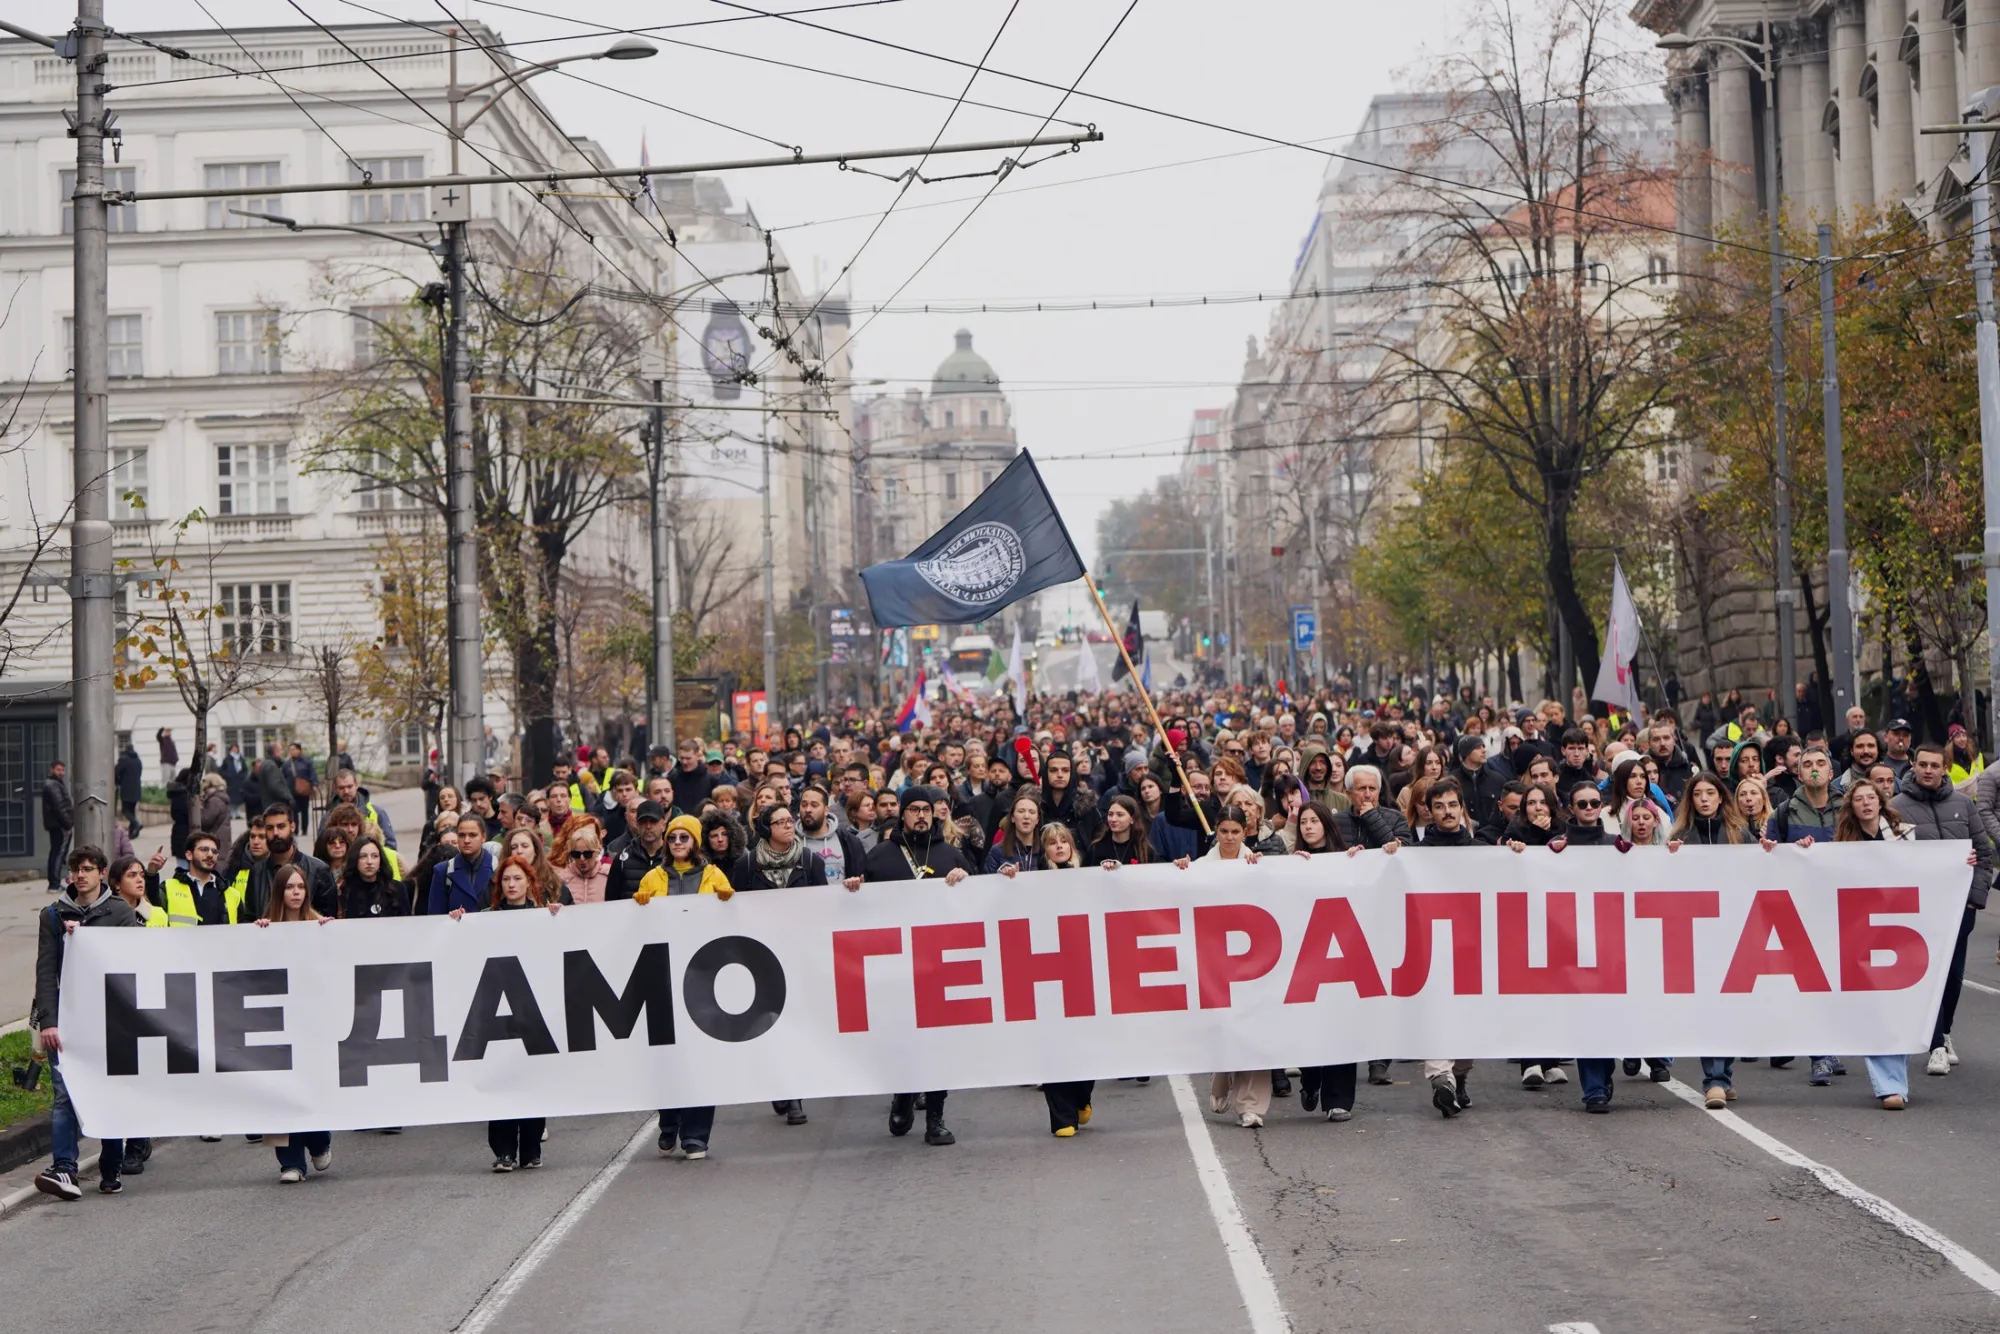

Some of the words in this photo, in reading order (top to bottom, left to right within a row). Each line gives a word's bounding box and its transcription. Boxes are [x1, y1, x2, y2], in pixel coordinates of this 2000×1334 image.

[105, 969, 293, 1076] НЕ
[338, 936, 786, 1087] ДАМО
[833, 887, 1929, 1032] ГЕНЕРАЛШТАБ
